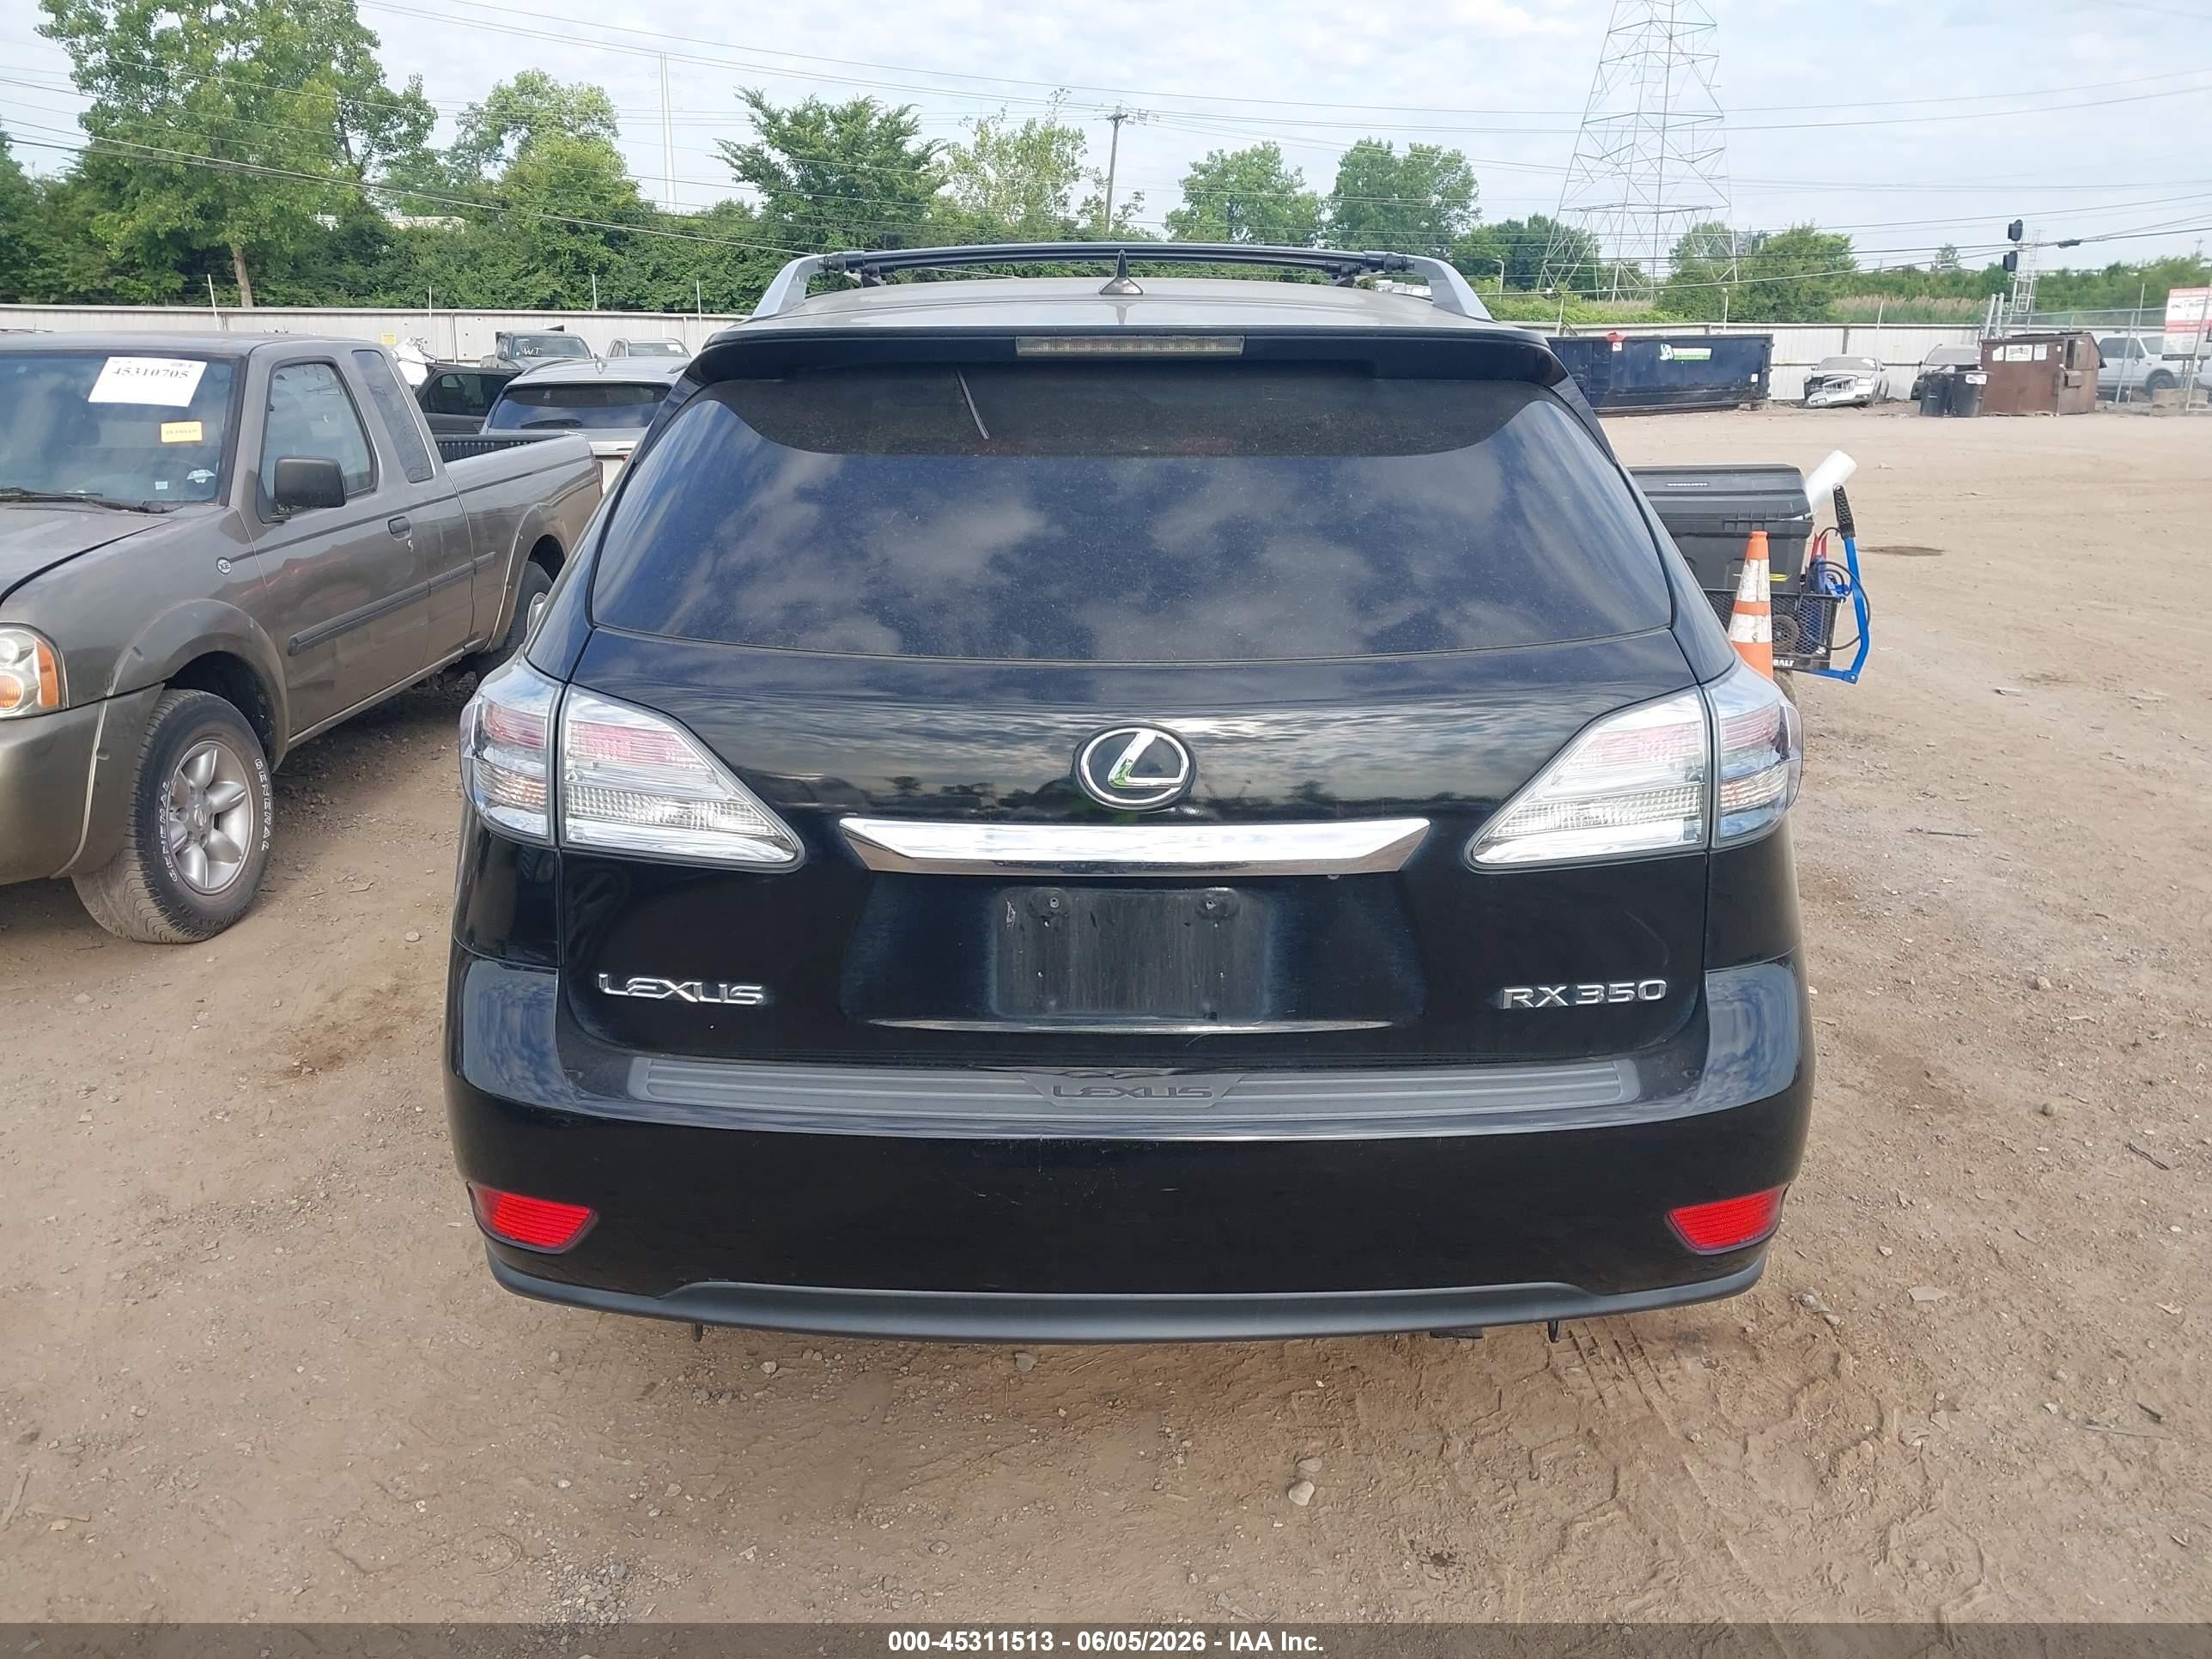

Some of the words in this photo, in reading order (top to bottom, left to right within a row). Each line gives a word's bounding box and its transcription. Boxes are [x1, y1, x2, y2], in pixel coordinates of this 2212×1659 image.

[112, 368, 190, 379] 45310705
[254, 758, 270, 852] GENERAL
[158, 781, 179, 883] GENERAL
[599, 974, 763, 1006] LEXUS
[1052, 1085, 1214, 1098] LEXUS
